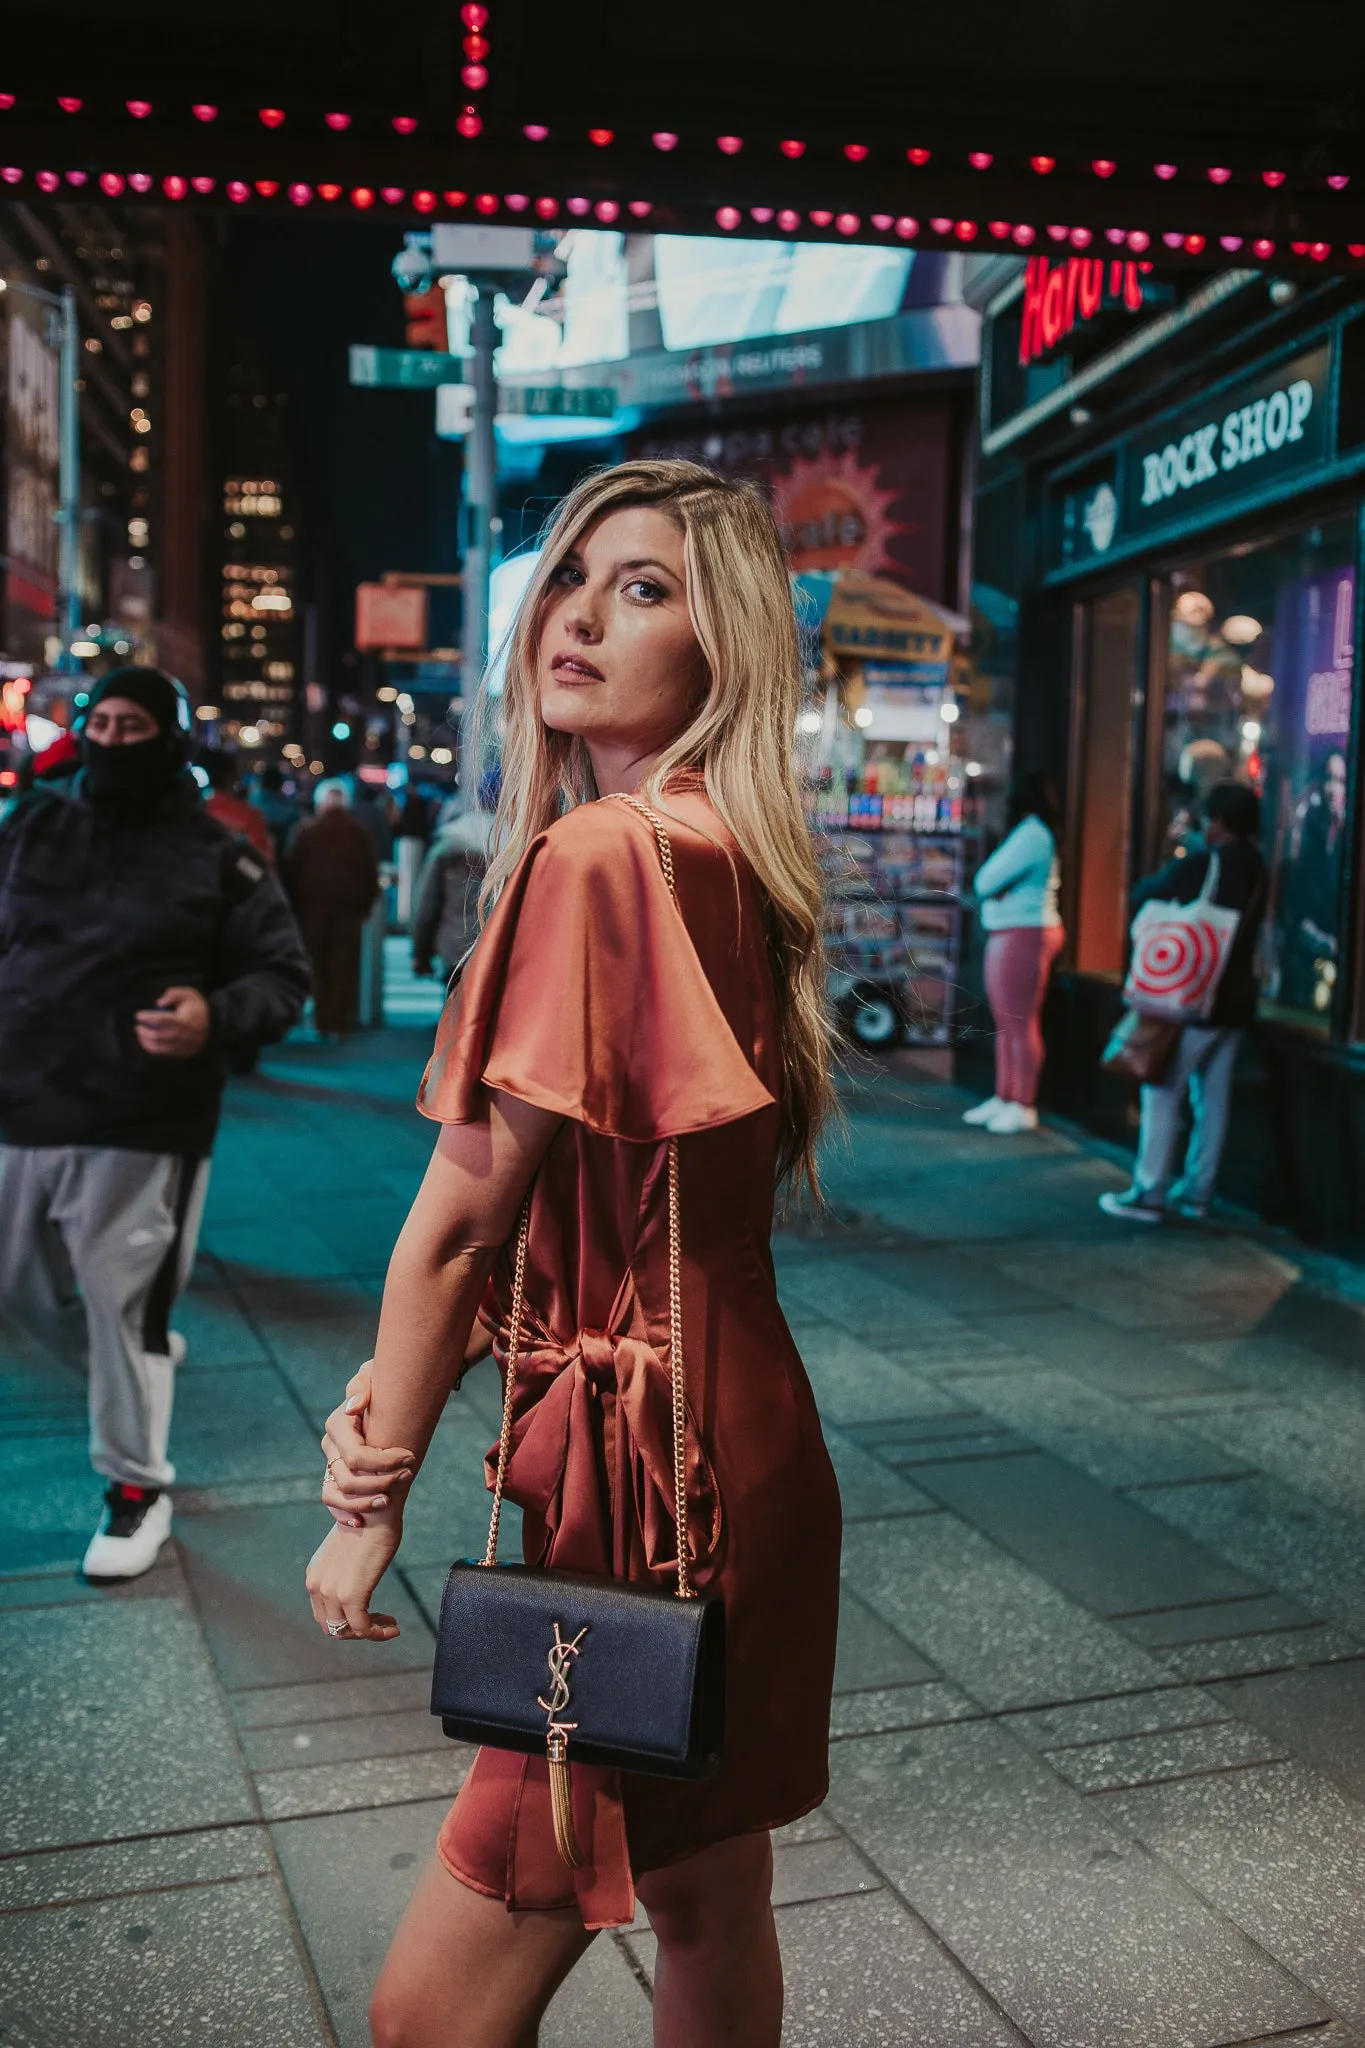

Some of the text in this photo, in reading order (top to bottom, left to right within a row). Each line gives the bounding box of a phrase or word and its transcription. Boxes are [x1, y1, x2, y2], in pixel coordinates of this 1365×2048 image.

[1141, 379, 1313, 506] ROCK SHOP
[537, 1622, 588, 1729] YSL
